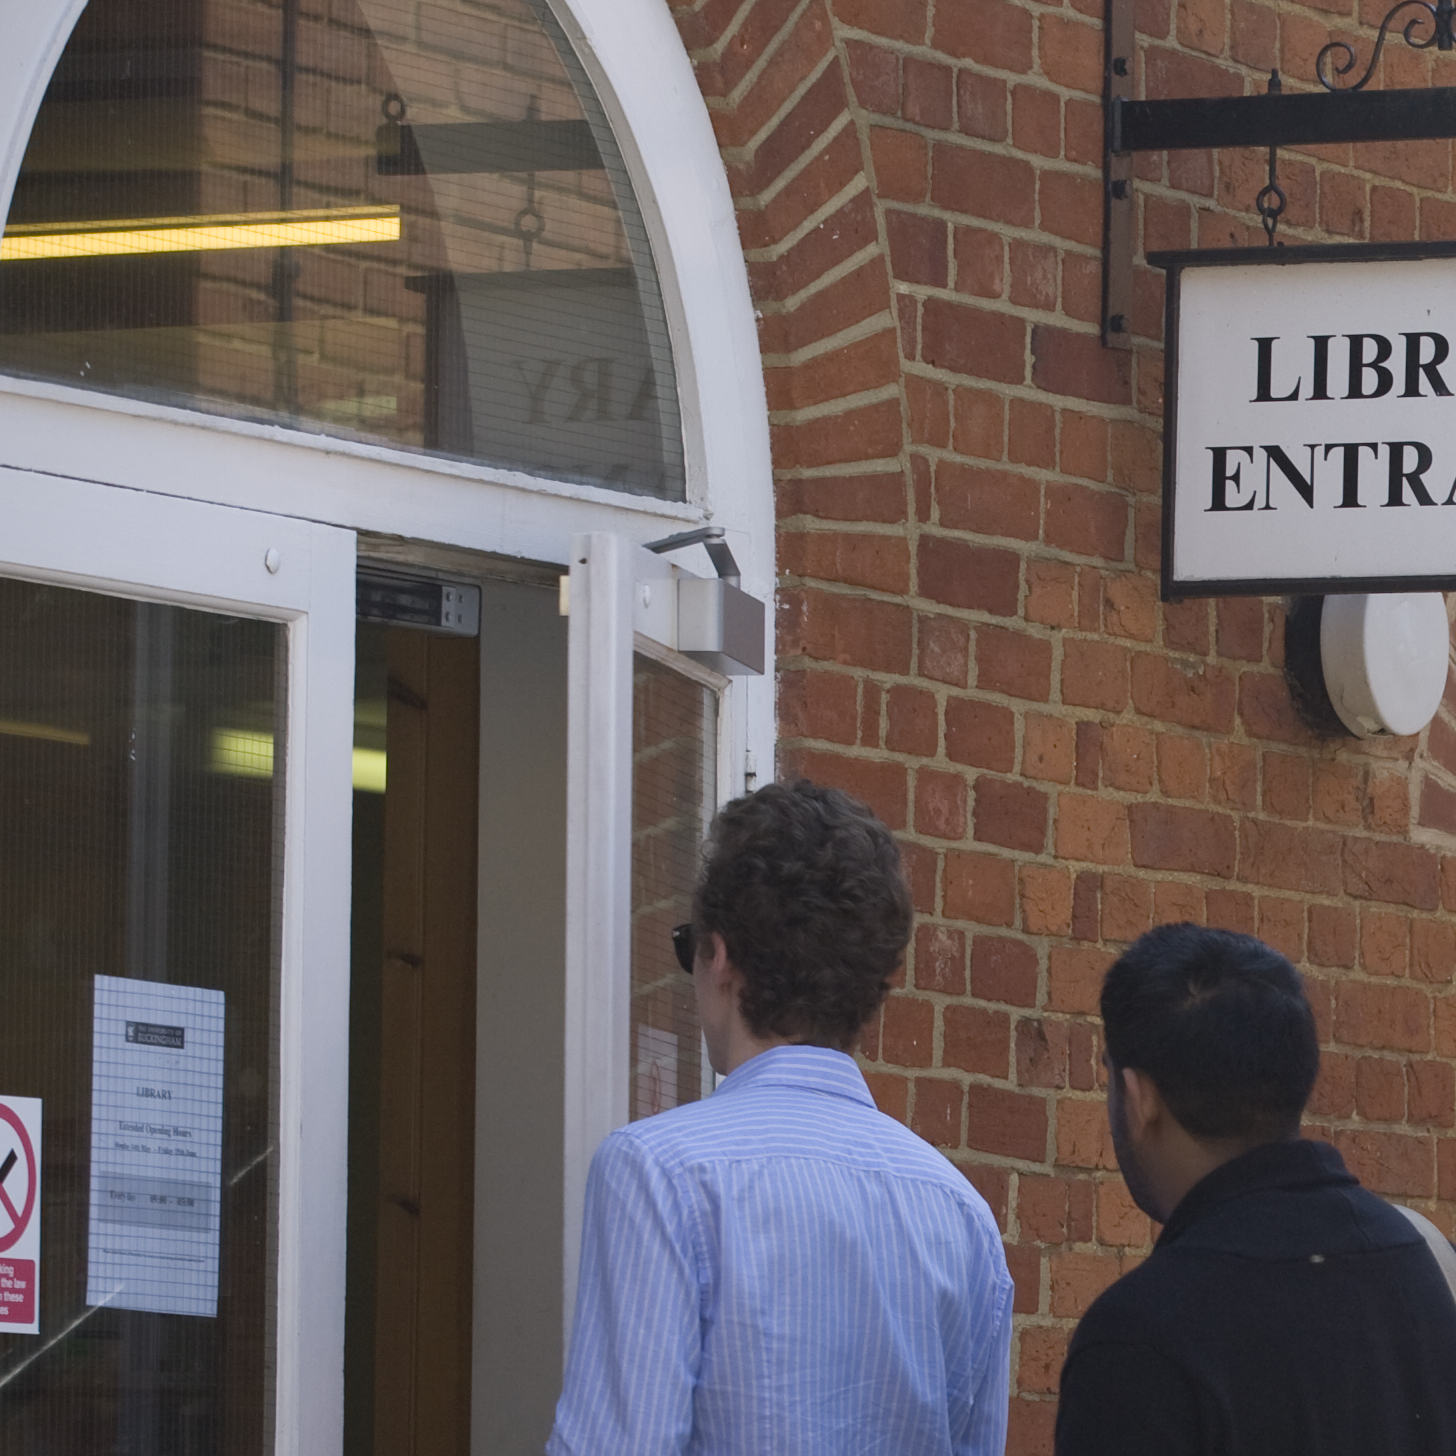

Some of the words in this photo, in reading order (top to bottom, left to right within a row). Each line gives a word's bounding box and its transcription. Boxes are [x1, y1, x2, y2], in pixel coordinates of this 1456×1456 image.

[136, 1086, 172, 1100] LIBRARY
[1, 1278, 13, 1288] the
[14, 1278, 26, 1288] law
[4, 1291, 24, 1302] these
